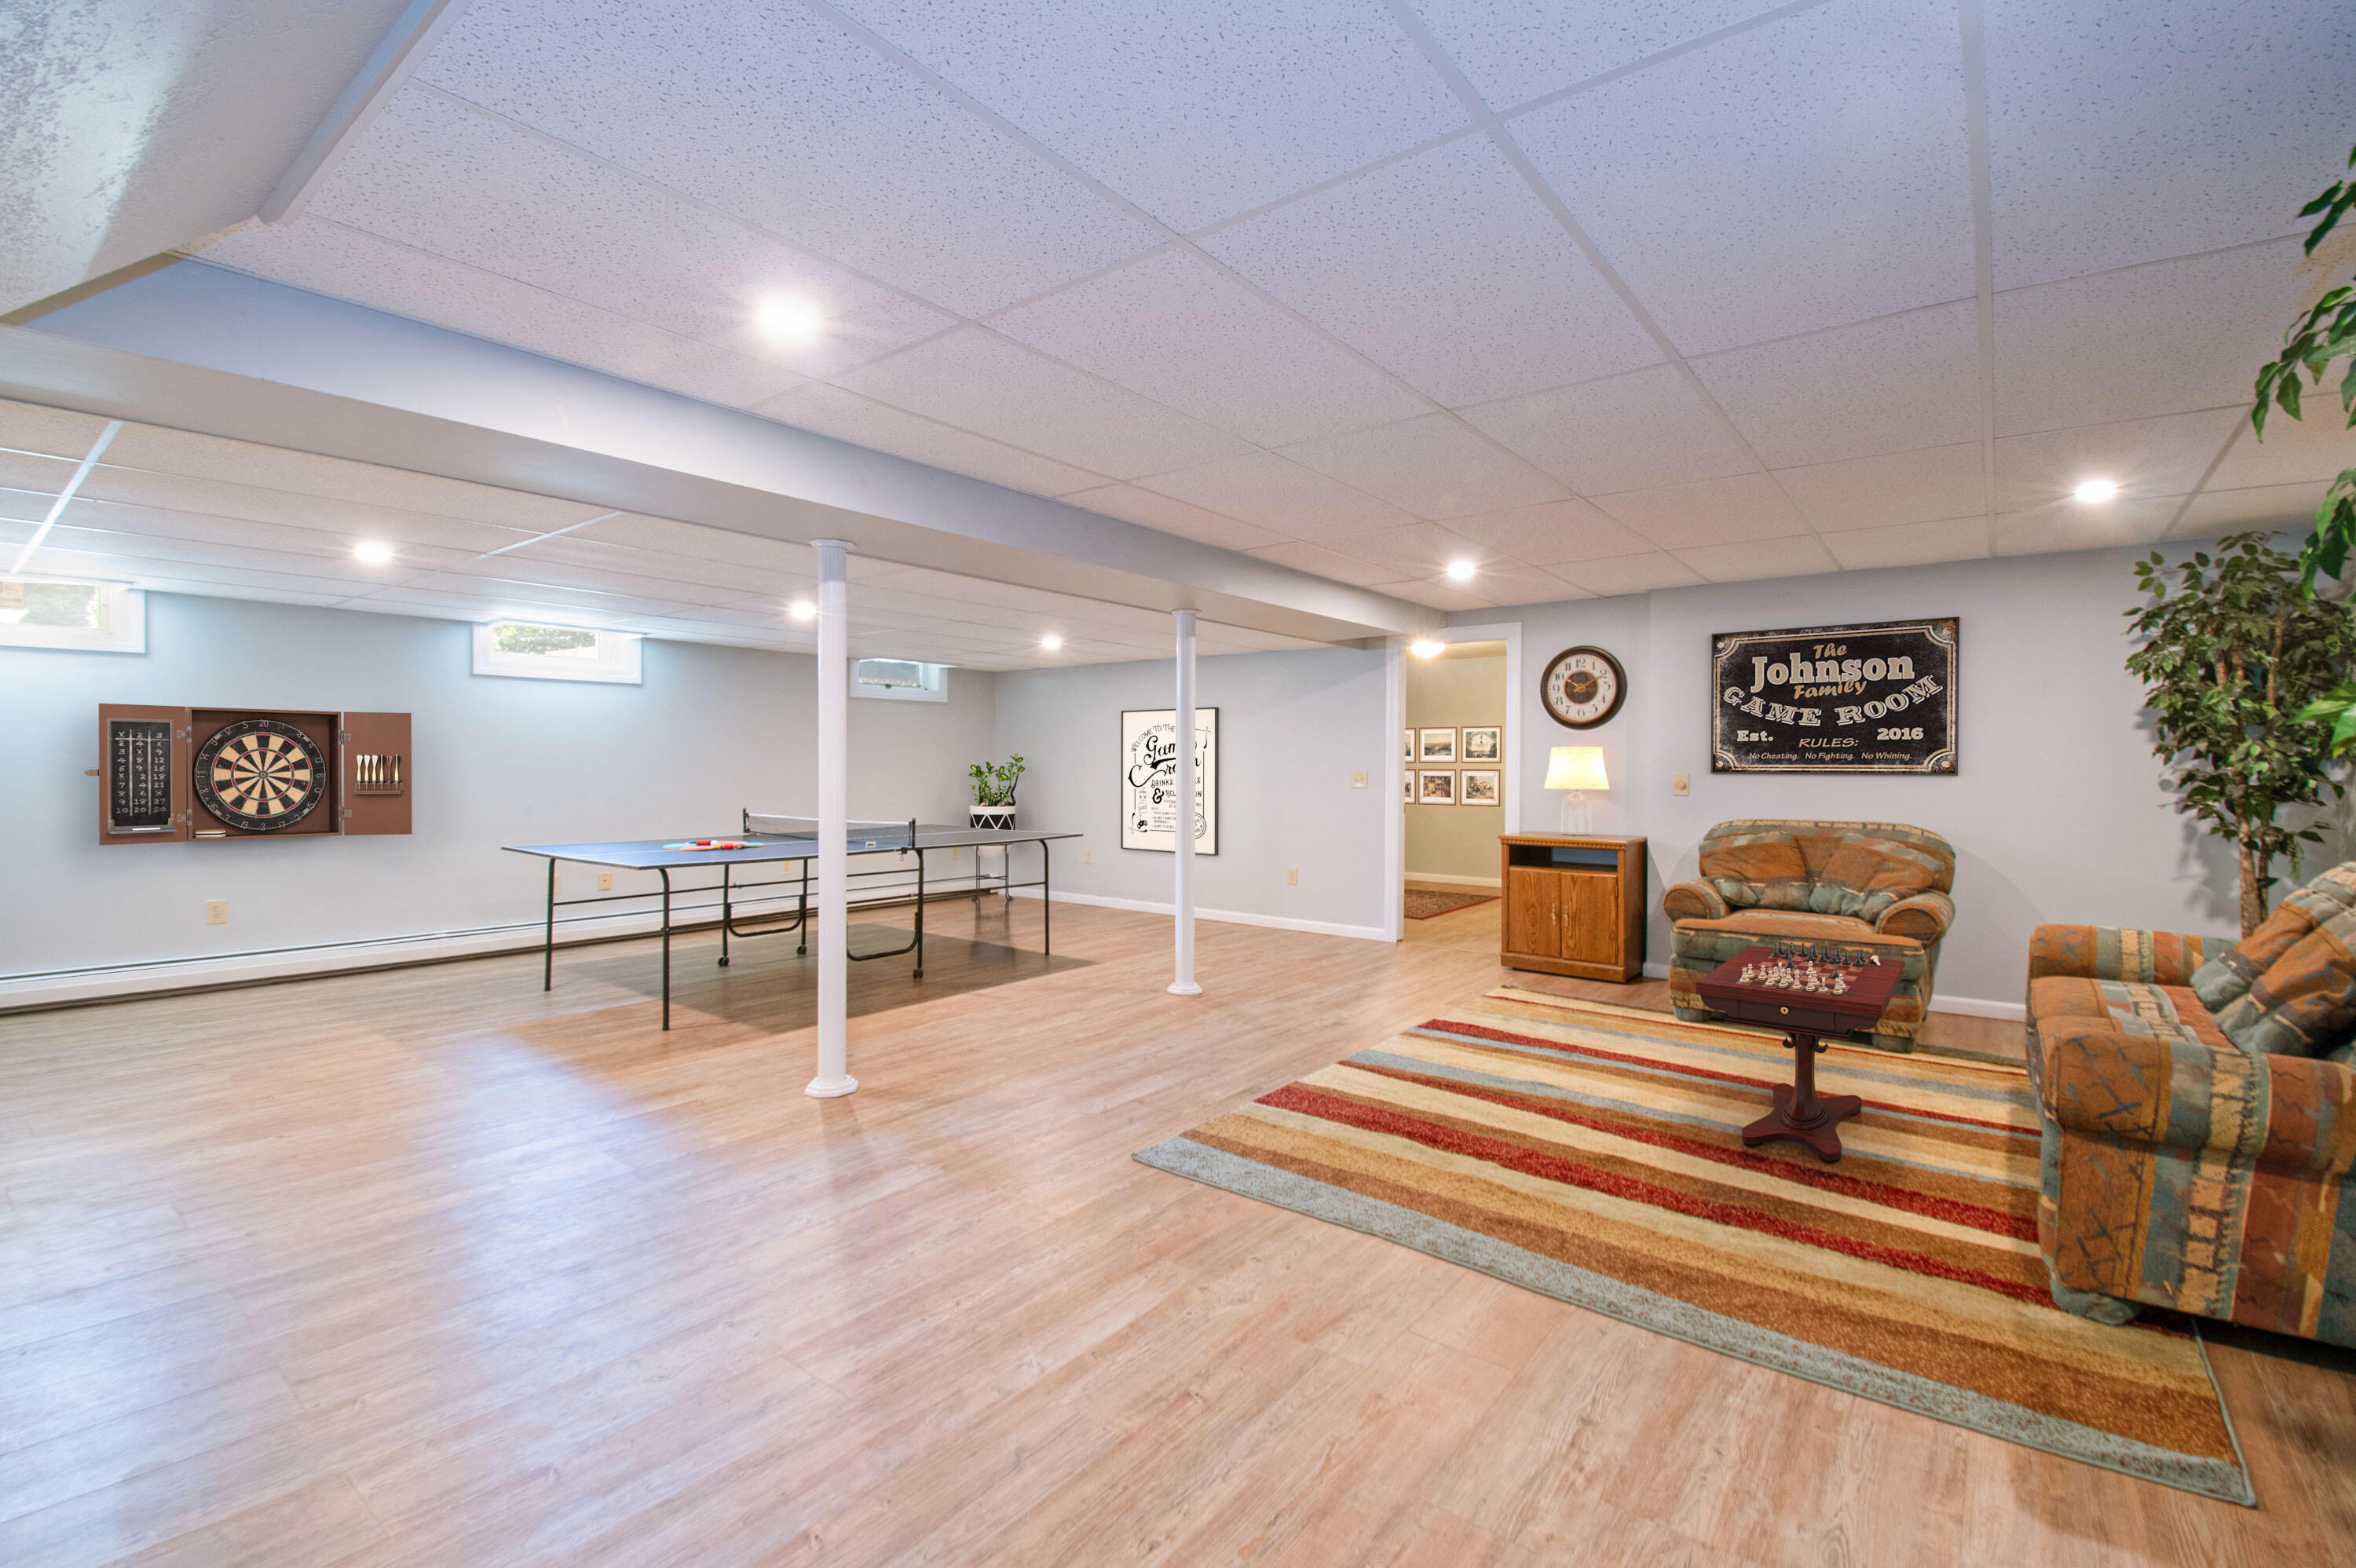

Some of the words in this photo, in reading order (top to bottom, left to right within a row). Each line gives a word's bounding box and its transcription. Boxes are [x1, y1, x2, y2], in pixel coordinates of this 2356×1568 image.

[1813, 643, 1847, 659] The
[1565, 663, 1571, 671] 11
[1576, 658, 1586, 668] 12
[1593, 661, 1595, 671] 1
[1555, 673, 1564, 682] 10
[1600, 669, 1607, 678] 2
[1751, 652, 1915, 693] Johnson
[1553, 684, 1560, 693] 9
[1794, 679, 1867, 699] Family
[1723, 686, 1821, 726] GAME
[1834, 675, 1943, 726] ROOM
[1566, 705, 1571, 714] 7
[1736, 730, 1774, 742] Est.
[1877, 727, 1923, 740] 2016
[1131, 729, 1152, 752] WELCOME
[1798, 737, 1859, 747] RULES:
[1152, 788, 1164, 804] &
